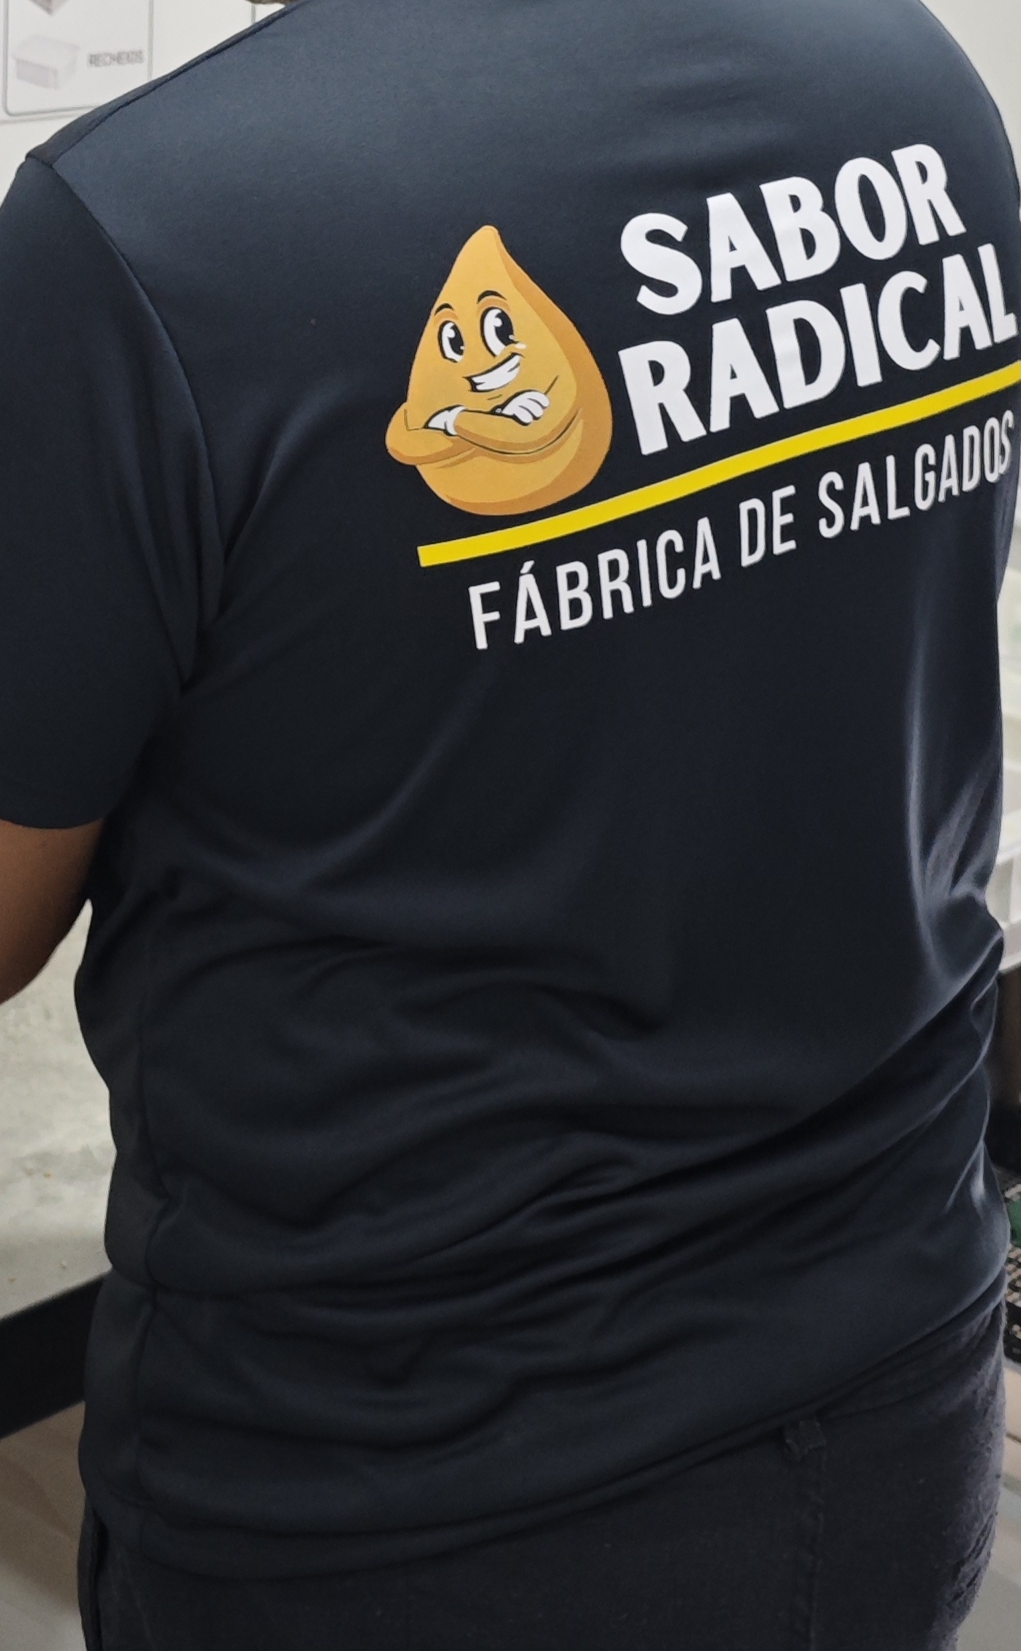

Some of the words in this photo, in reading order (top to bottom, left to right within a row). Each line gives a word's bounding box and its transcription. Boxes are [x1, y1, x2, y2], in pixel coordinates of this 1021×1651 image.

[620, 143, 967, 316] SABOR
[618, 242, 1019, 456] RADICAL
[468, 516, 722, 650] FÁBRICA
[739, 485, 798, 568] DE
[817, 409, 1015, 540] SALGADOS
